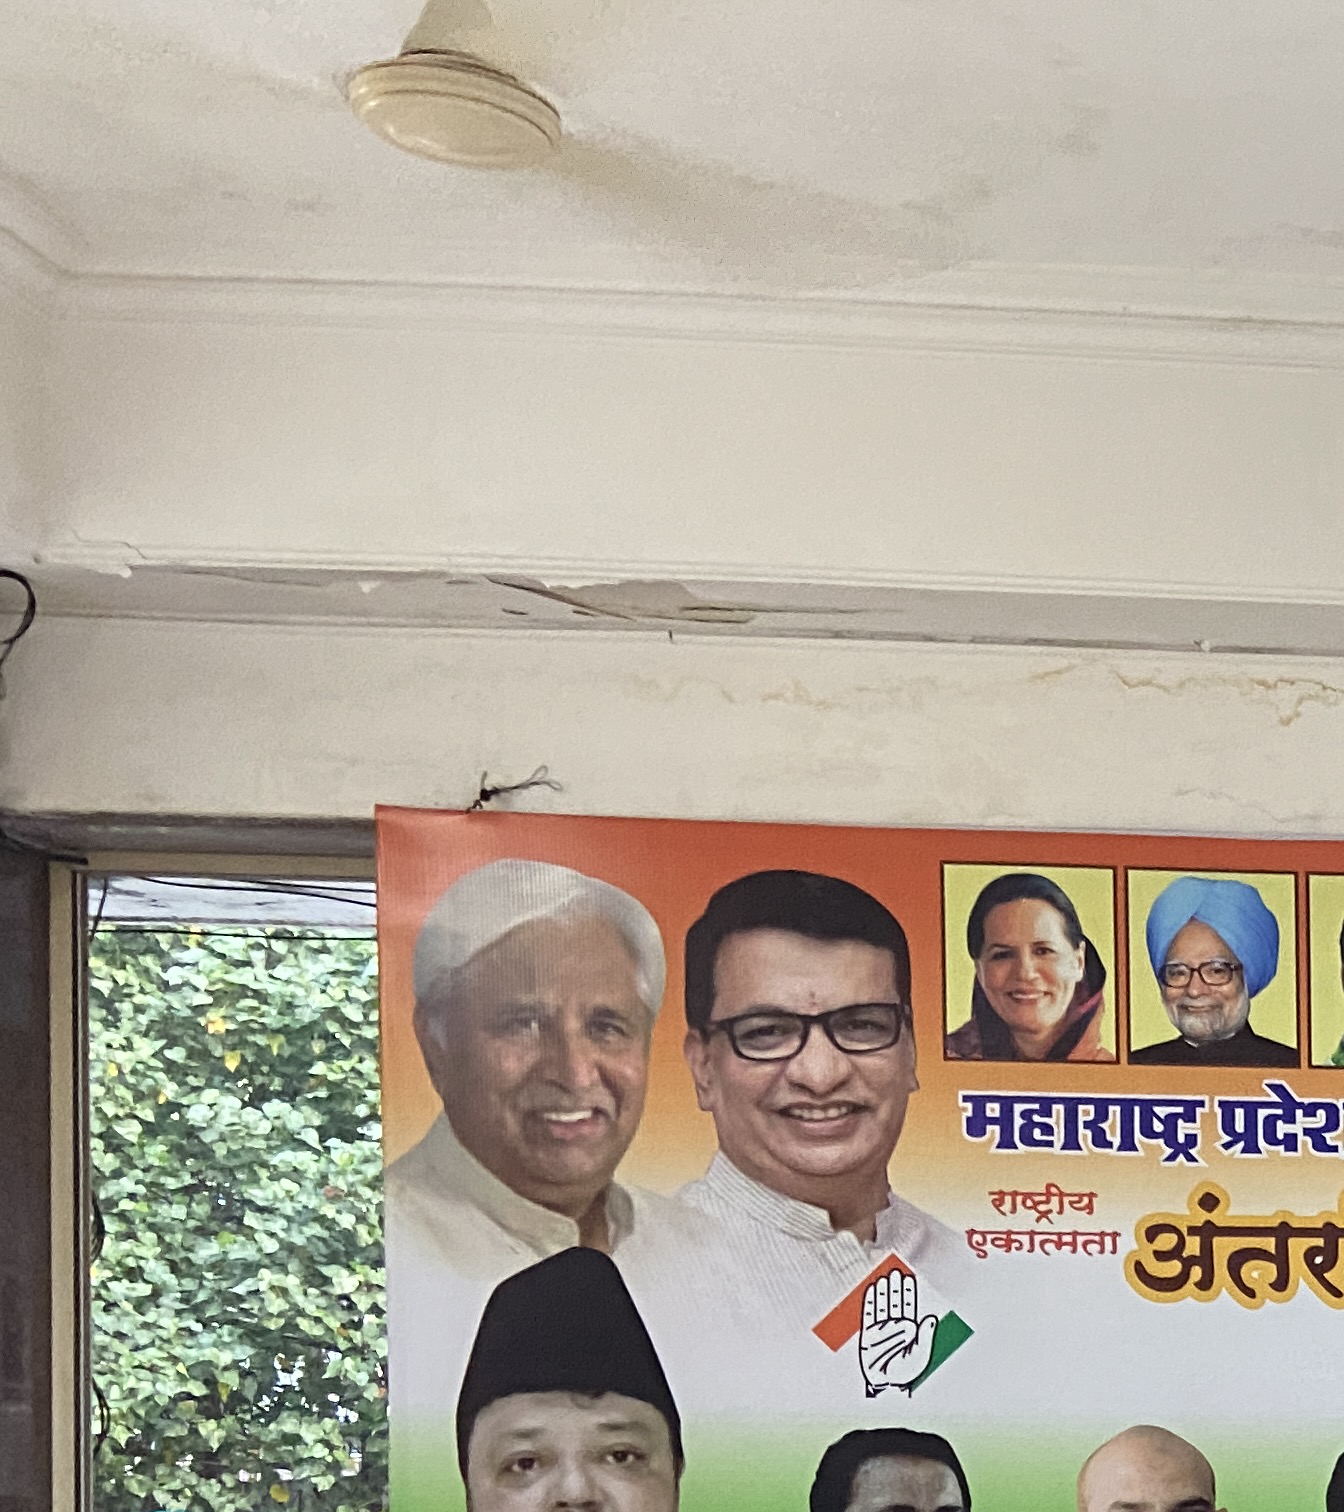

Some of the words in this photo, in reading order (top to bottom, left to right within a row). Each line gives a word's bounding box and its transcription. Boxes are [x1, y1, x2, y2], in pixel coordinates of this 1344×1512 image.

[959, 1091, 1204, 1166] महाराष्ट्र
[989, 1183, 1097, 1224] राष्ट्रीय
[966, 1228, 1121, 1258] एकात्मता
